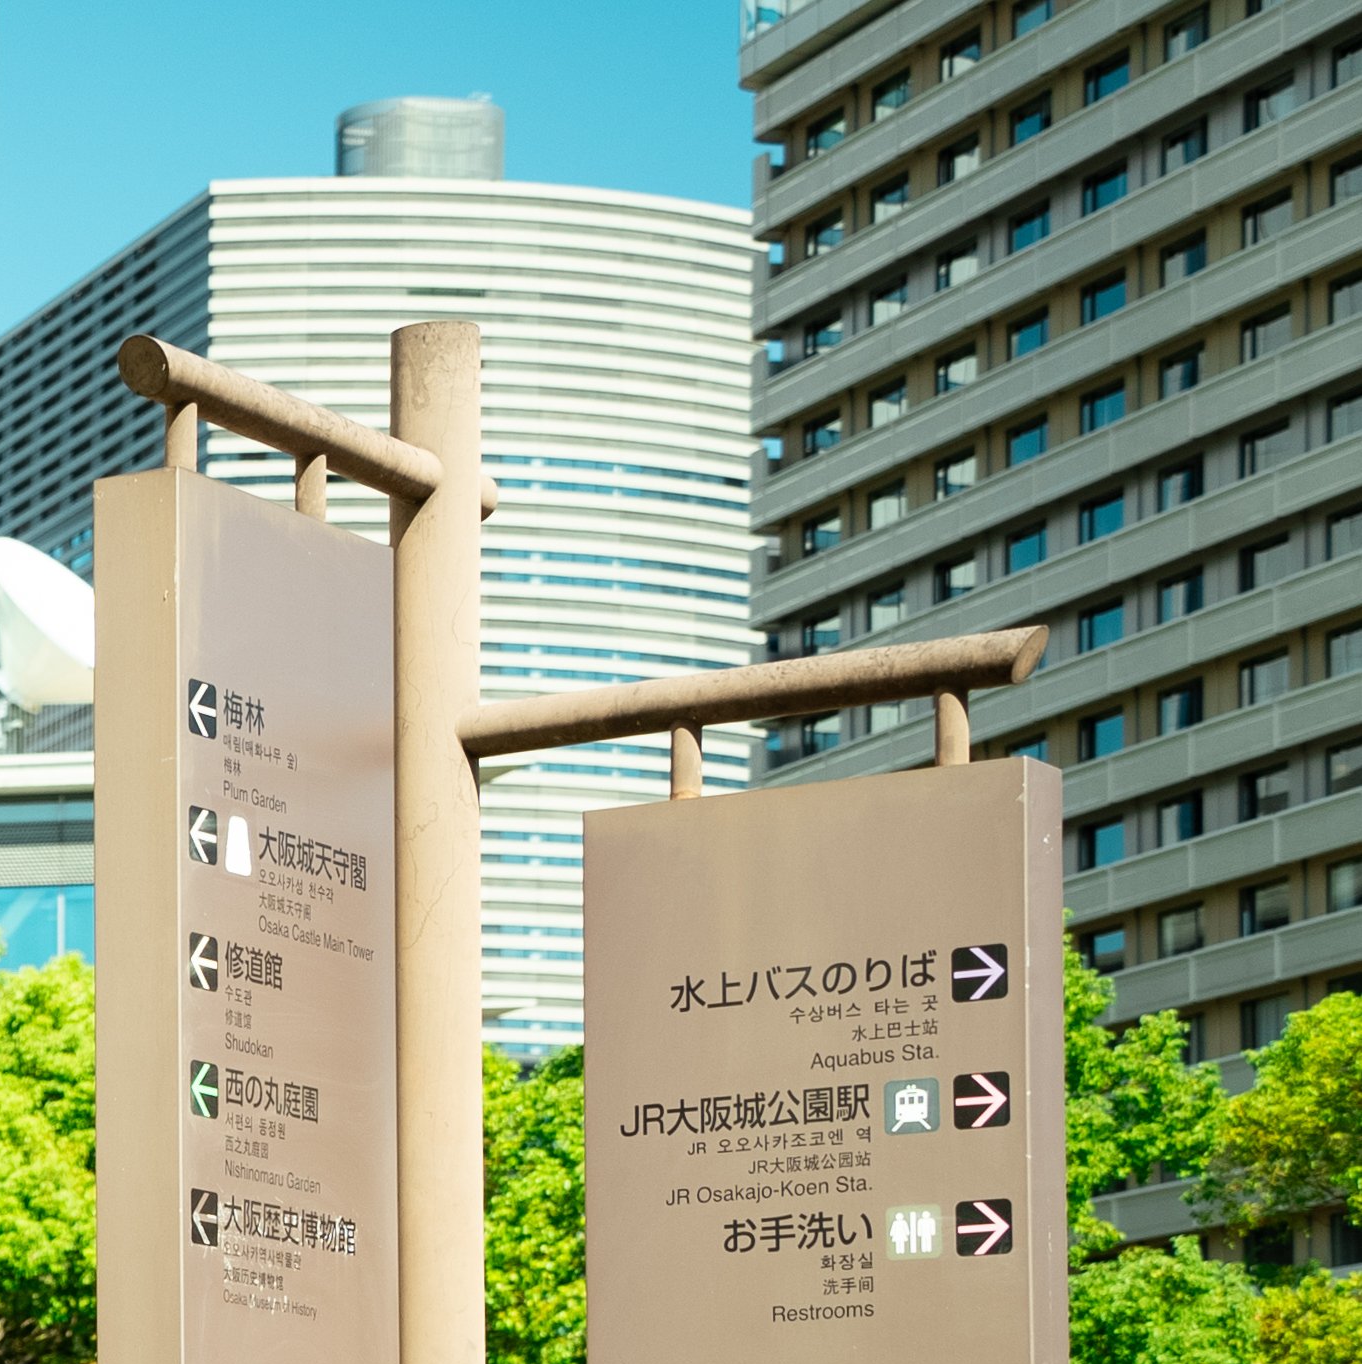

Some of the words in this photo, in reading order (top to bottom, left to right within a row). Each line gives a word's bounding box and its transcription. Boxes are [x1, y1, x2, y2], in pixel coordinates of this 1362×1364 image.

[223, 688, 265, 736] 梅林
[223, 779, 248, 803] Plum
[251, 788, 287, 814] Garden
[258, 825, 367, 891] 大阪城天守閣
[258, 868, 303, 896] 오오사카성
[308, 878, 334, 904] 천수각
[259, 915, 289, 938] Osaka
[292, 924, 321, 947] Castle
[323, 932, 345, 954] Main
[347, 939, 374, 962] Tower
[225, 940, 283, 991] 修道館
[670, 950, 937, 1013] 水上バスのりば
[225, 984, 252, 1007] 수도관
[789, 1001, 862, 1024] 수상버스
[874, 998, 911, 1016] 타는
[922, 994, 939, 1013] 곳
[225, 1032, 274, 1059] Shudokan
[851, 1019, 939, 1043] 水上巴士站
[810, 1044, 895, 1072] Aquabus
[901, 1043, 940, 1062] Sta.
[225, 1067, 319, 1124] 西の丸庭園
[620, 1083, 870, 1138] JR大阪城公園駅
[687, 1142, 707, 1156] JR
[716, 1130, 844, 1154] 오오사카조코엔
[856, 1126, 873, 1144] 역
[225, 1159, 284, 1187] Nishinomaru
[286, 1172, 321, 1194] Garden
[748, 1150, 872, 1175] JR大阪城公园站
[665, 1189, 690, 1207] JR
[696, 1180, 830, 1206] Osakajo-Koen
[836, 1175, 874, 1193] Sta.
[224, 1195, 356, 1256] 大阪歴史博物館
[722, 1210, 874, 1254] お手洗い
[820, 1251, 874, 1272] 화장실
[822, 1276, 874, 1296] 洗手间
[223, 1289, 248, 1306] Osaka
[291, 1300, 317, 1321] History
[772, 1302, 875, 1323] Restrooms
